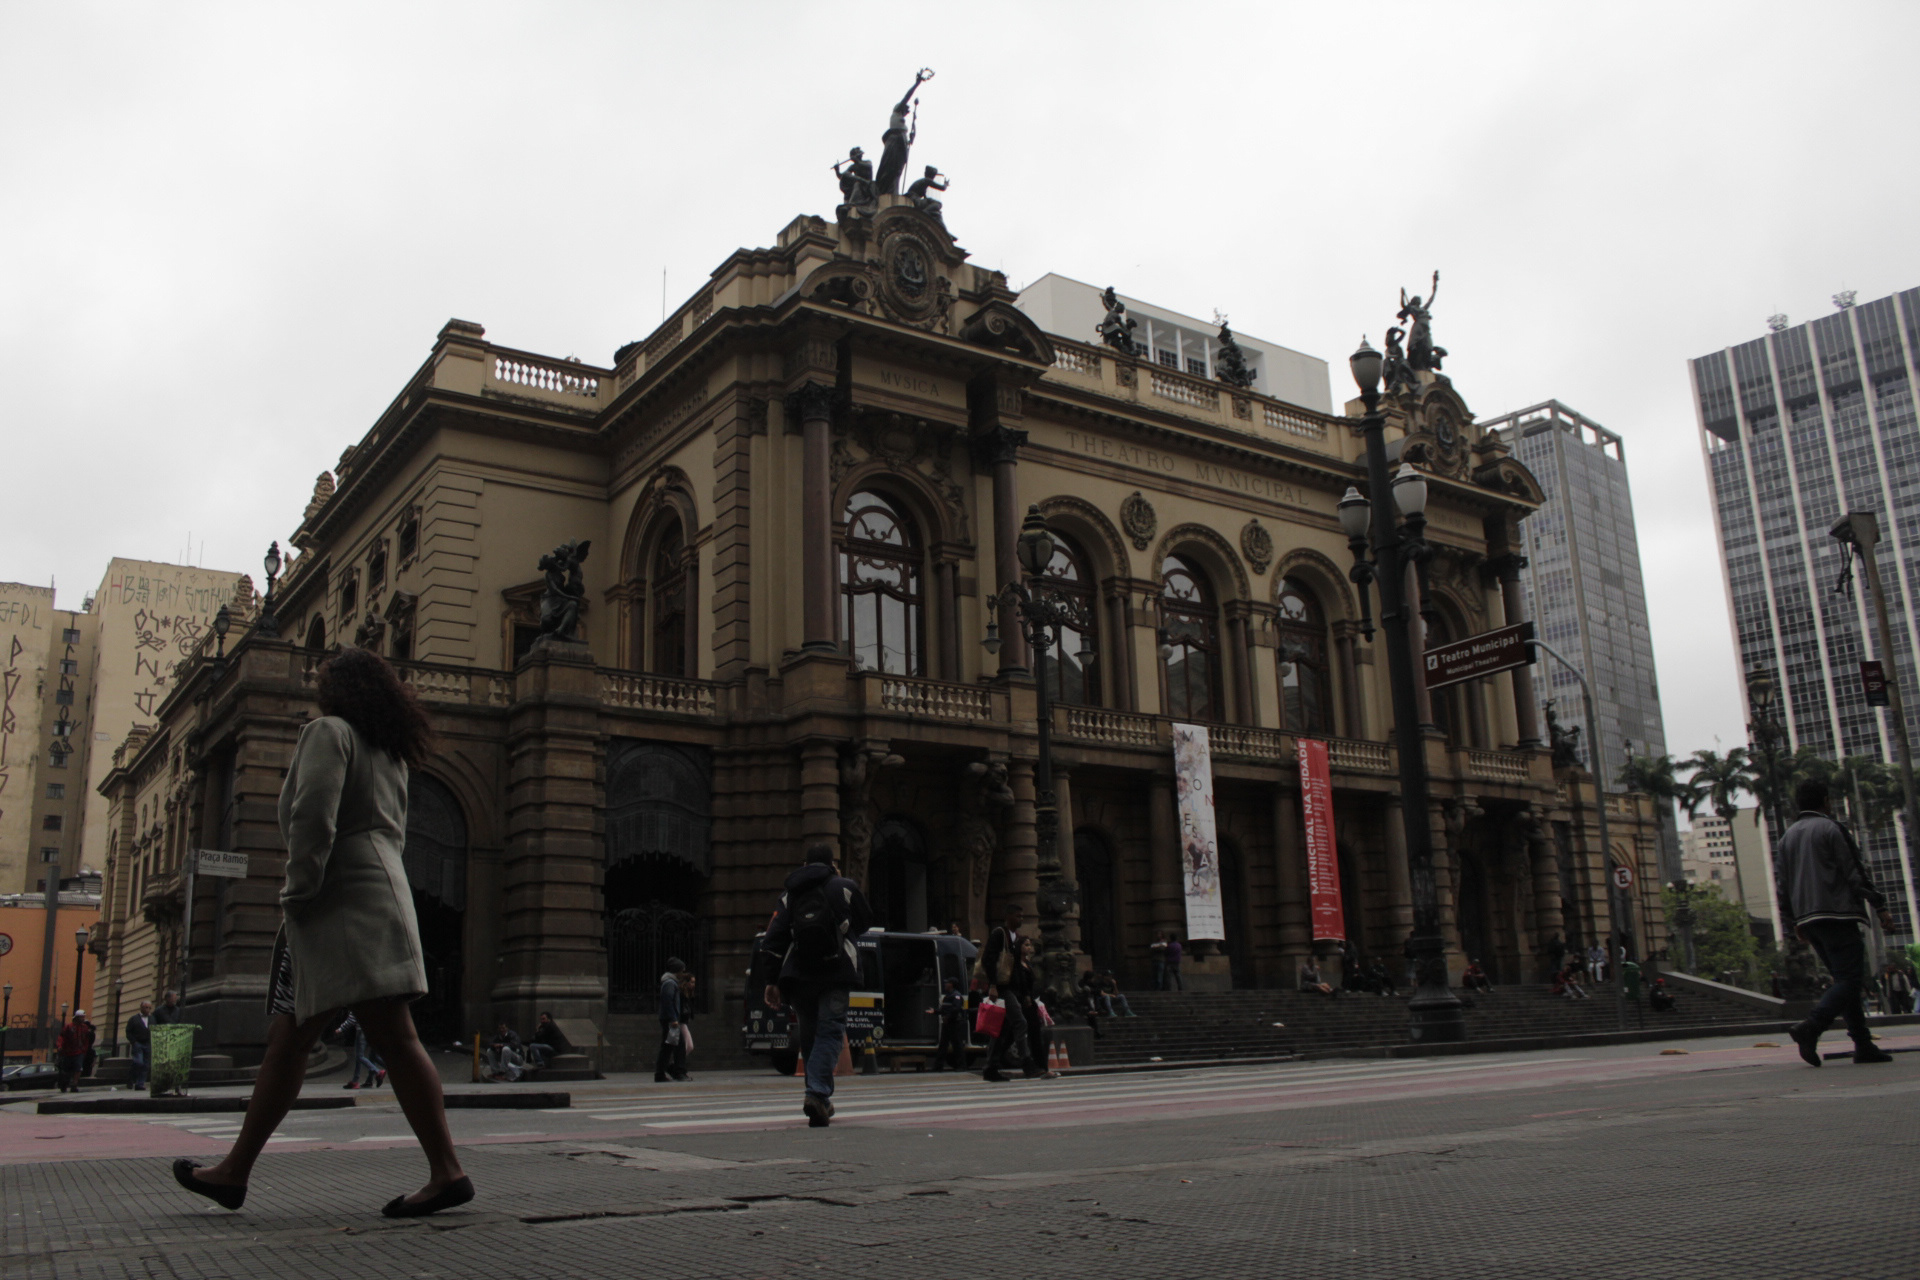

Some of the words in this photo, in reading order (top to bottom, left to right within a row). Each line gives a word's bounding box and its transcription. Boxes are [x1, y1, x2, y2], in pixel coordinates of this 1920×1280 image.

[880, 370, 940, 397] MVSICA
[1066, 431, 1175, 472] THEATRO
[1195, 463, 1309, 506] MVNICIPAL
[1441, 650, 1470, 663] Teatro
[1472, 633, 1519, 655] Municipal
[1298, 741, 1311, 790] CIDADE
[1303, 793, 1313, 814] NA
[200, 851, 220, 864] Praça
[222, 853, 248, 865] Ramos
[1306, 818, 1319, 895] MUNICIPAL
